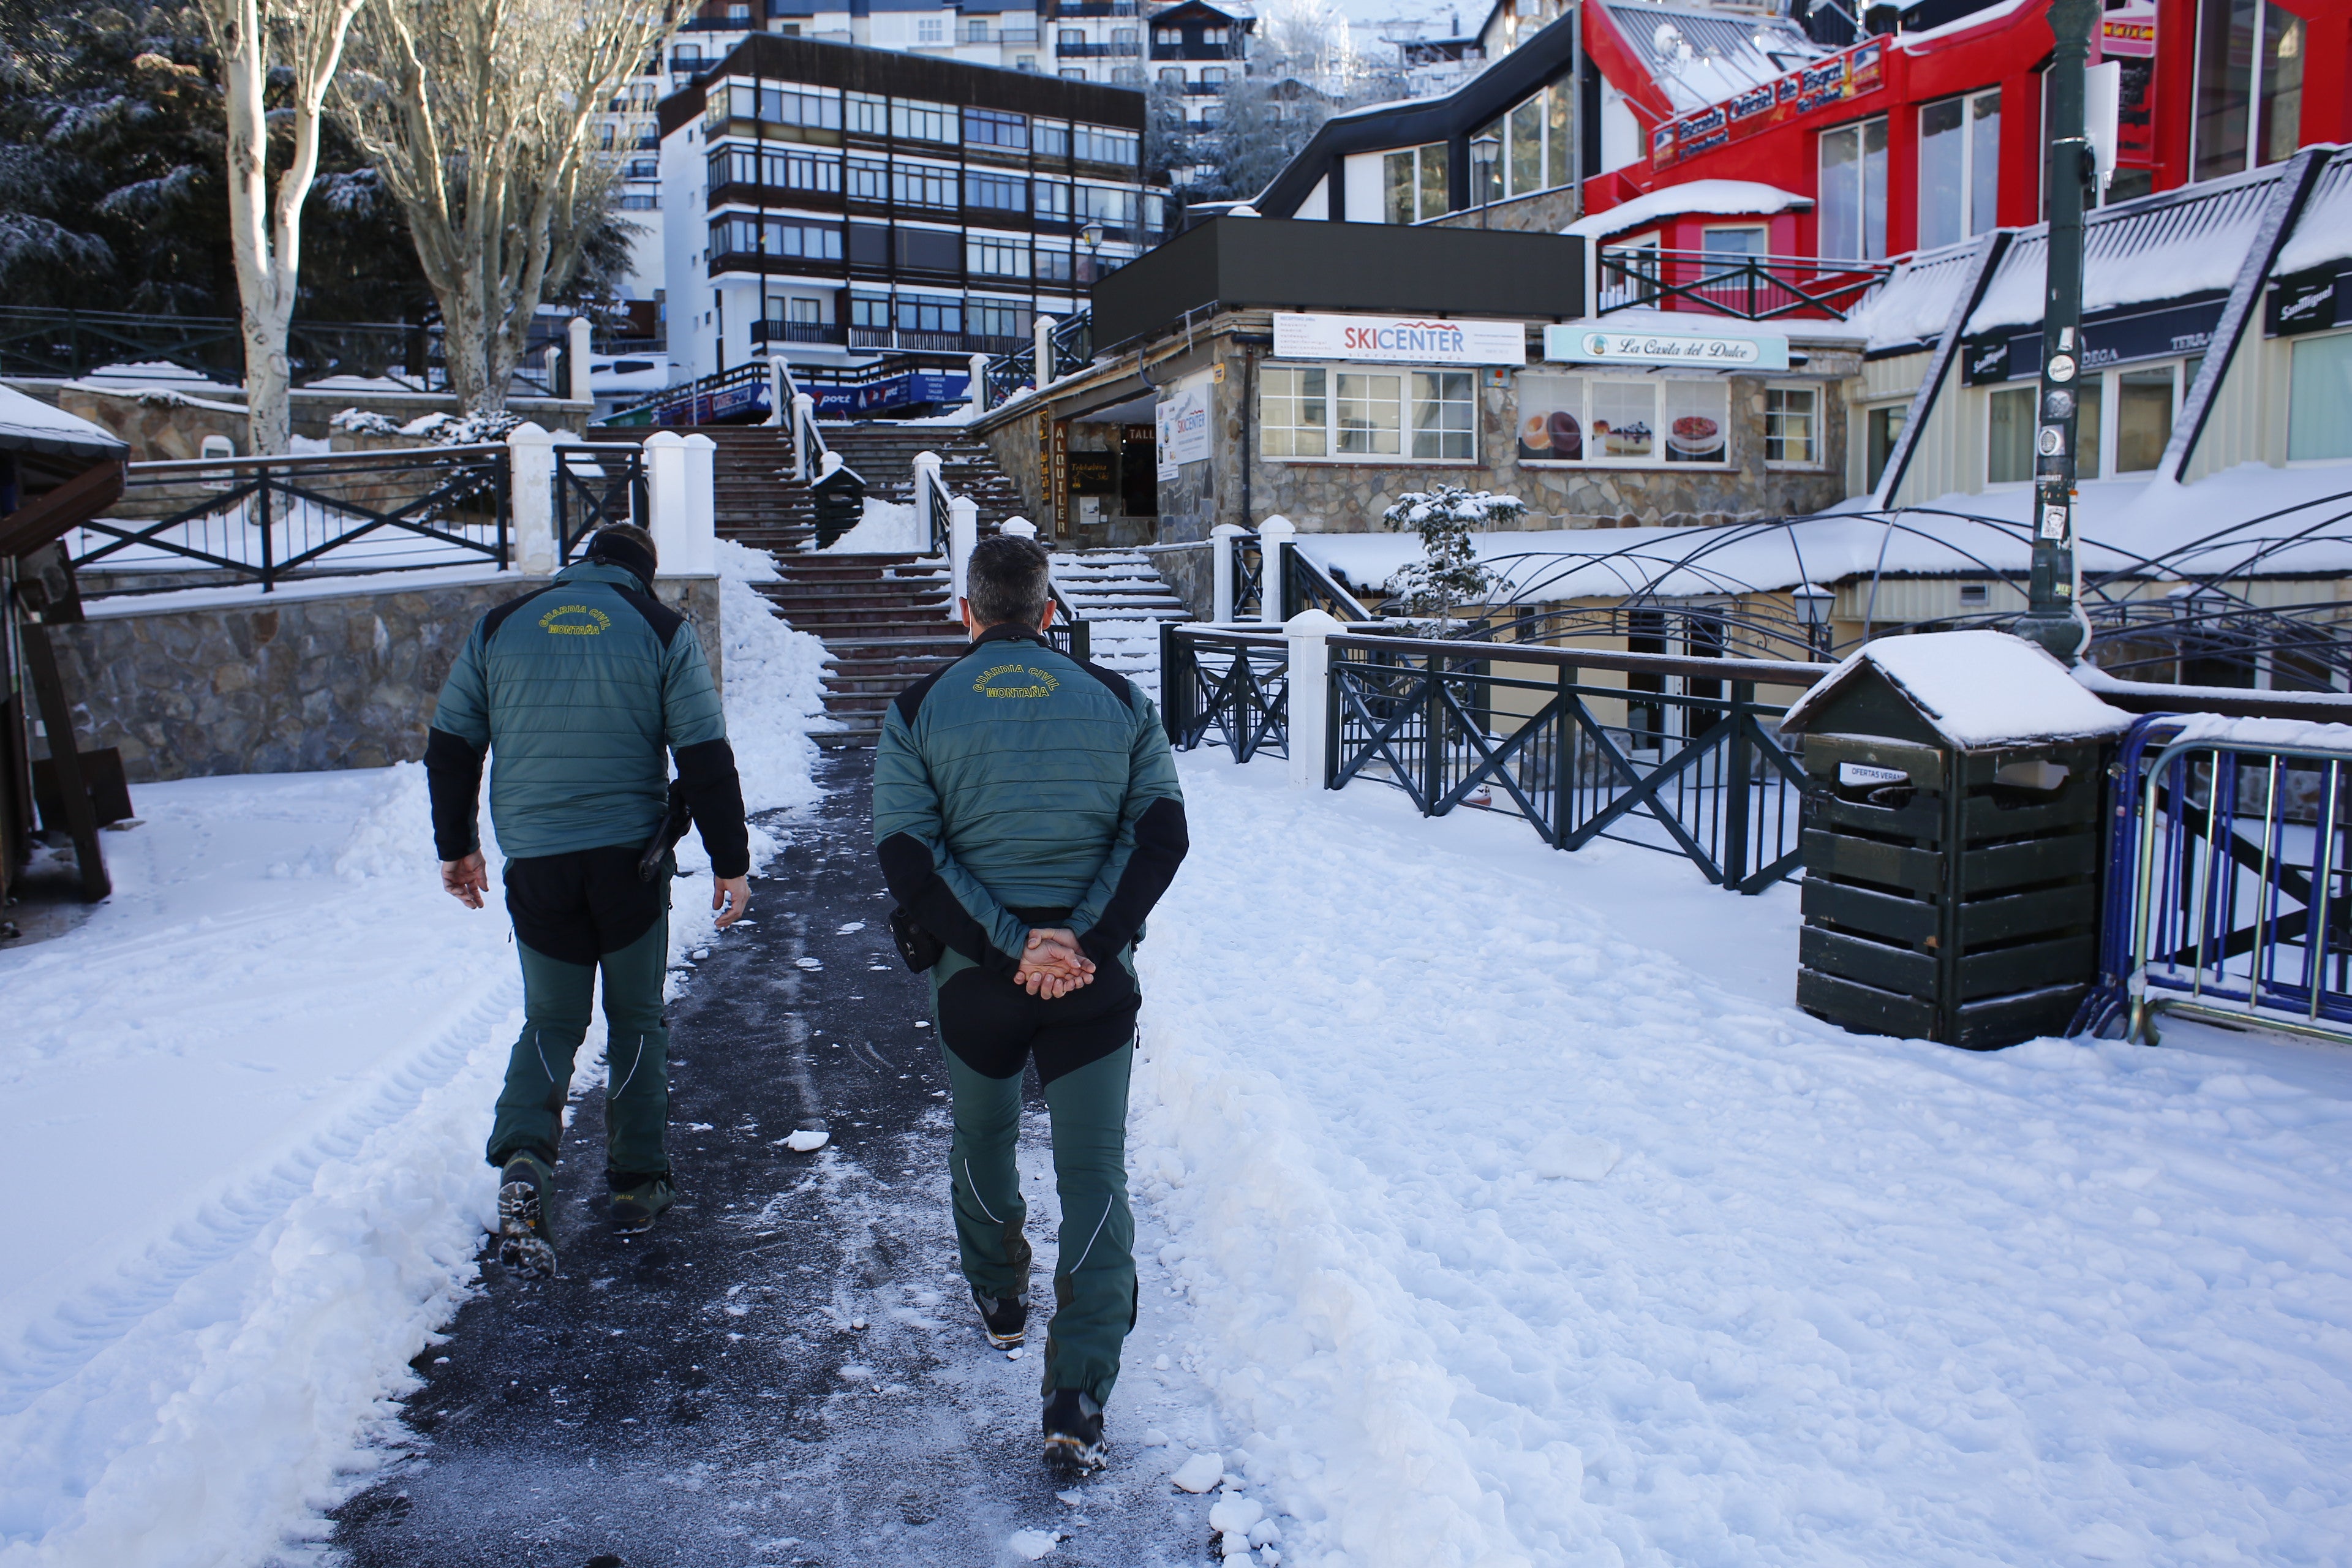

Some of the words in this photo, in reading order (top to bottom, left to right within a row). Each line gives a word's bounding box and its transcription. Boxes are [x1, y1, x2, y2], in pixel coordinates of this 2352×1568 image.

[1344, 326, 1464, 352] SKICENTER
[1618, 337, 1640, 353] La
[1644, 339, 1681, 355] Casita
[1684, 342, 1705, 356] del
[1708, 341, 1748, 358] Dulce
[1055, 427, 1065, 533] ALQUILER
[539, 605, 586, 628] GUARDIA
[589, 608, 611, 630] CIVIL
[548, 624, 600, 635] MONTAÑA
[973, 665, 1024, 692] GUARDIA
[1028, 667, 1060, 691] CIVIL
[986, 685, 1049, 698] MONTAÑA
[1852, 767, 1880, 778] OFERTAS
